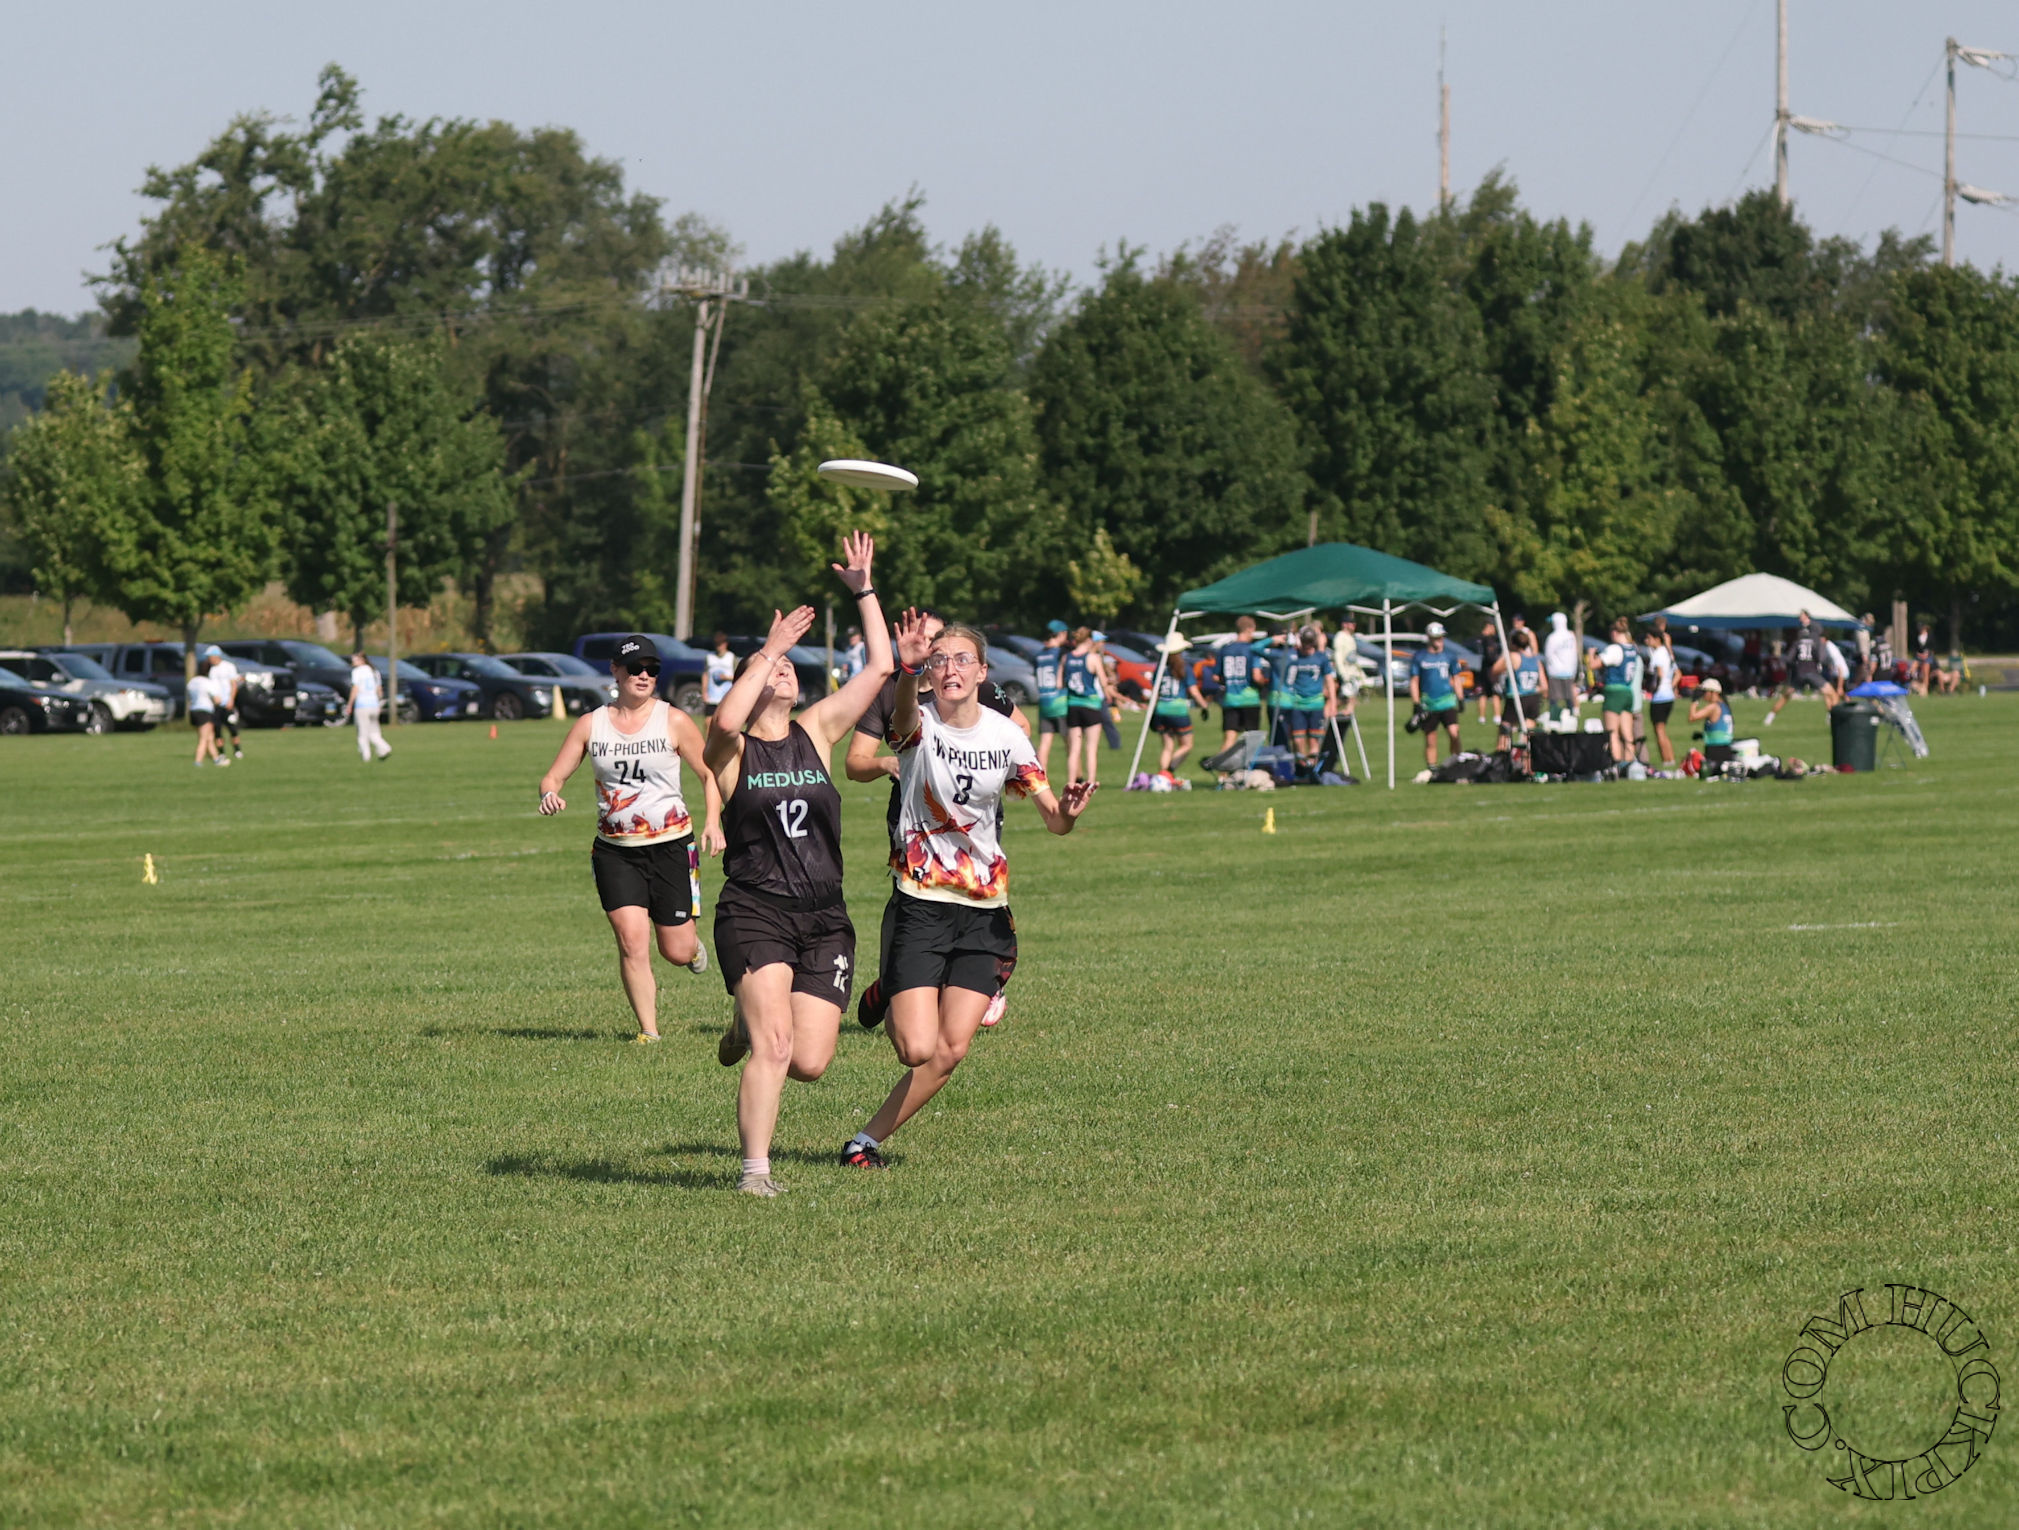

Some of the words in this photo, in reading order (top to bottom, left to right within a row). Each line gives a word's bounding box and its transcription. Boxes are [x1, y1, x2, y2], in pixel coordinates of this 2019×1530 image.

[591, 738, 667, 757] CW-PHOENIX
[614, 759, 647, 785] 24
[747, 769, 828, 790] MEDUSA
[953, 774, 973, 805] 3
[776, 799, 809, 838] 12
